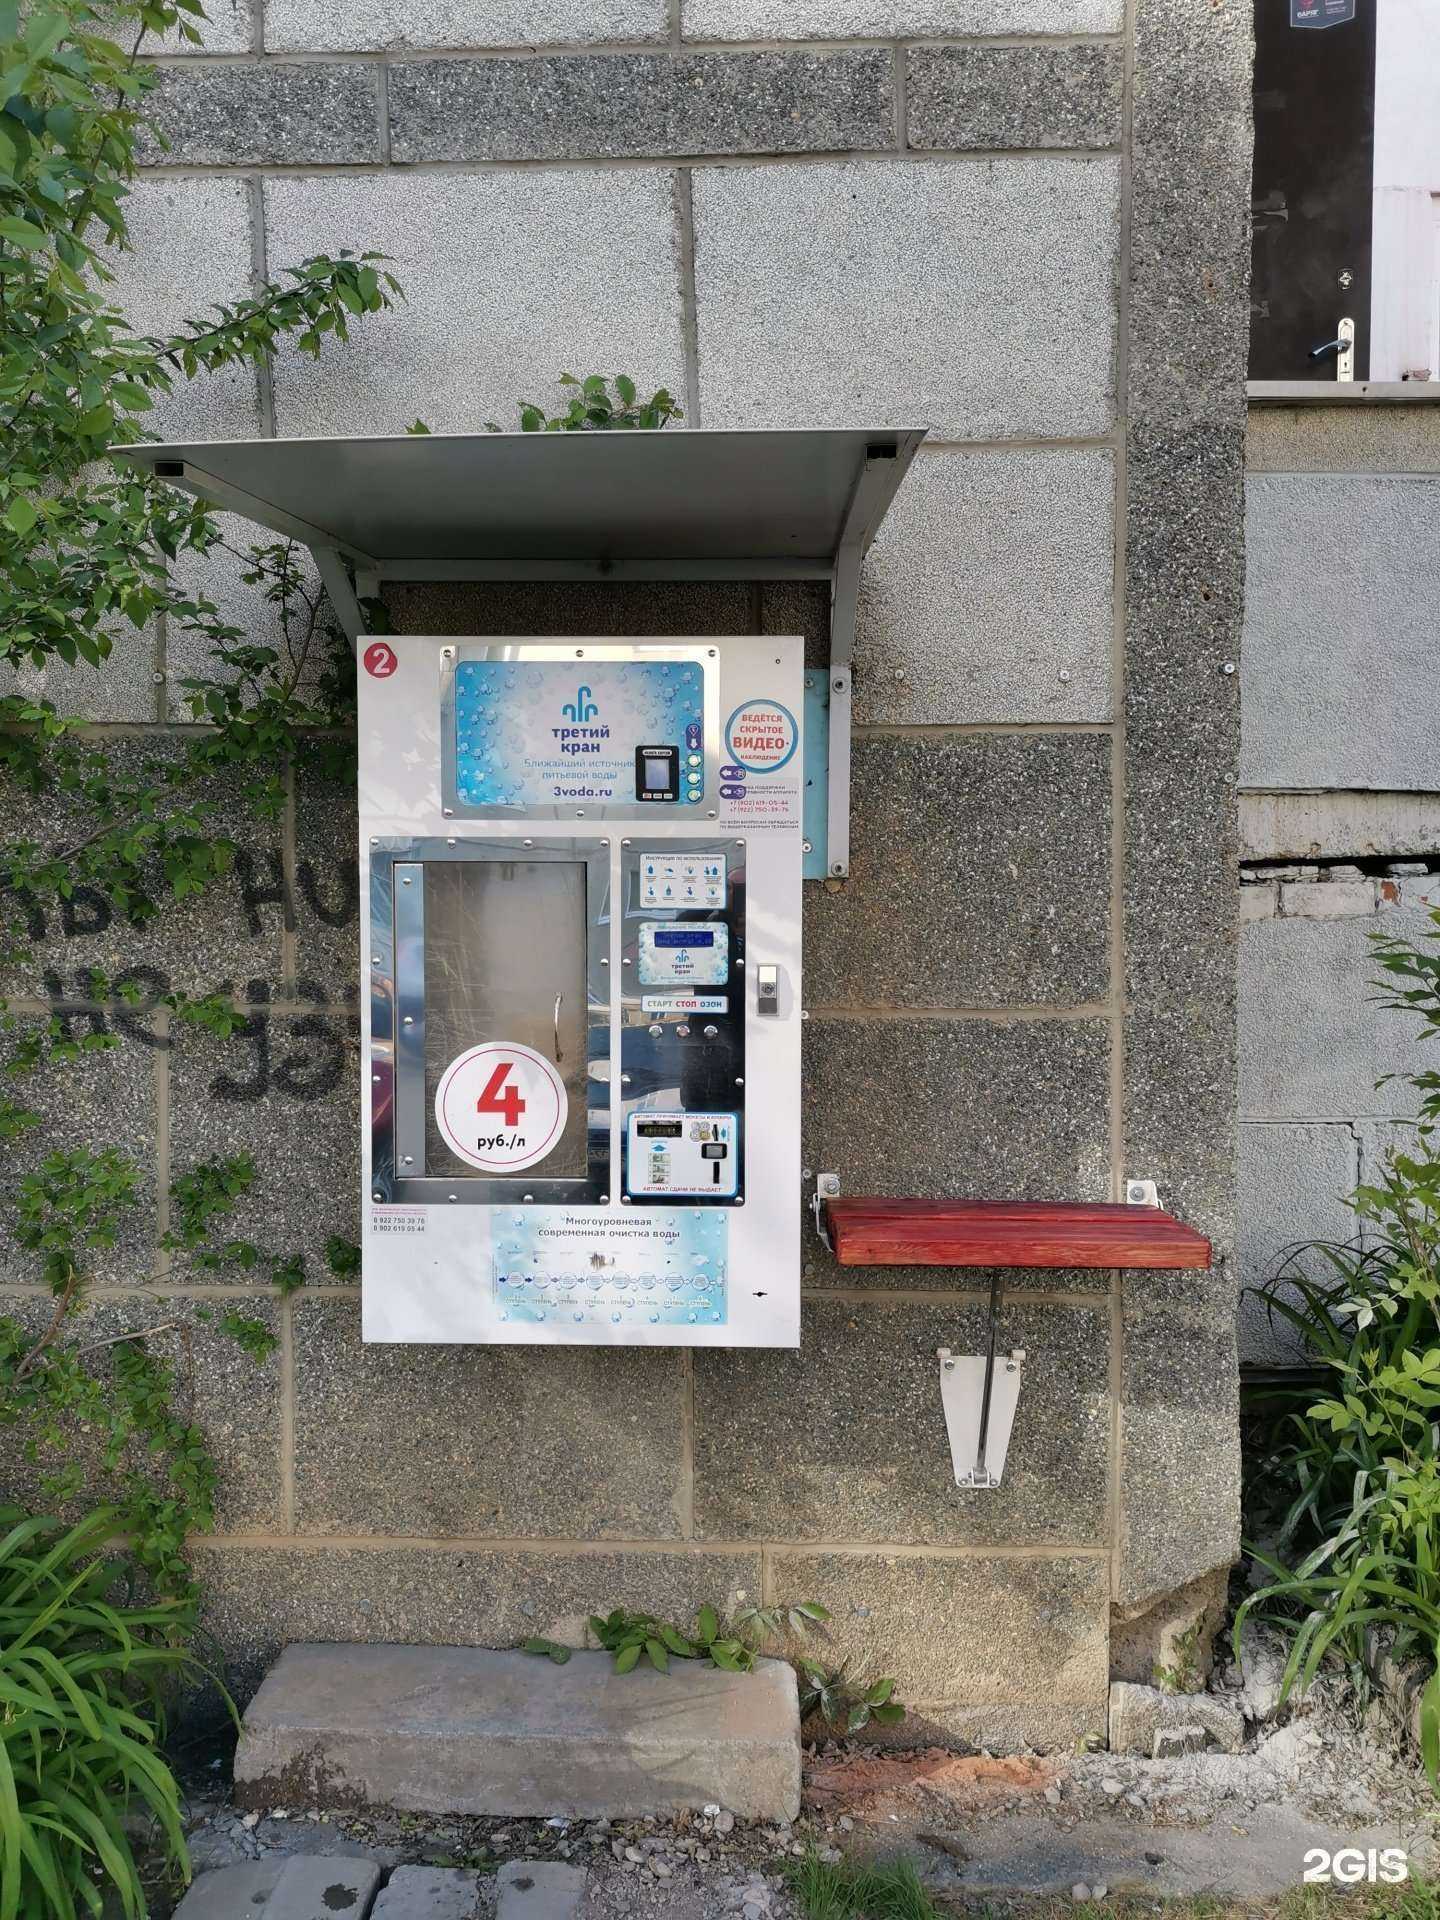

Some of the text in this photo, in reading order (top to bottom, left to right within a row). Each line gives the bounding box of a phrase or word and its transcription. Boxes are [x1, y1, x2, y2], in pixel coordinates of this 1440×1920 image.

[373, 648, 391, 674] 2
[742, 714, 783, 723] ВЕДЁТСЯ
[552, 725, 610, 741] третий
[740, 726, 784, 734] СКРЫТОЕ
[561, 742, 601, 756] кран
[524, 759, 586, 768] Ближайший
[542, 769, 590, 780] питьевой
[553, 786, 613, 798] 3voda.ru
[477, 1063, 525, 1126] 4
[477, 1134, 526, 1150] руб./л
[566, 1217, 652, 1226] Многоуровневая
[538, 1229, 605, 1238] современная
[609, 1230, 650, 1238] очистка
